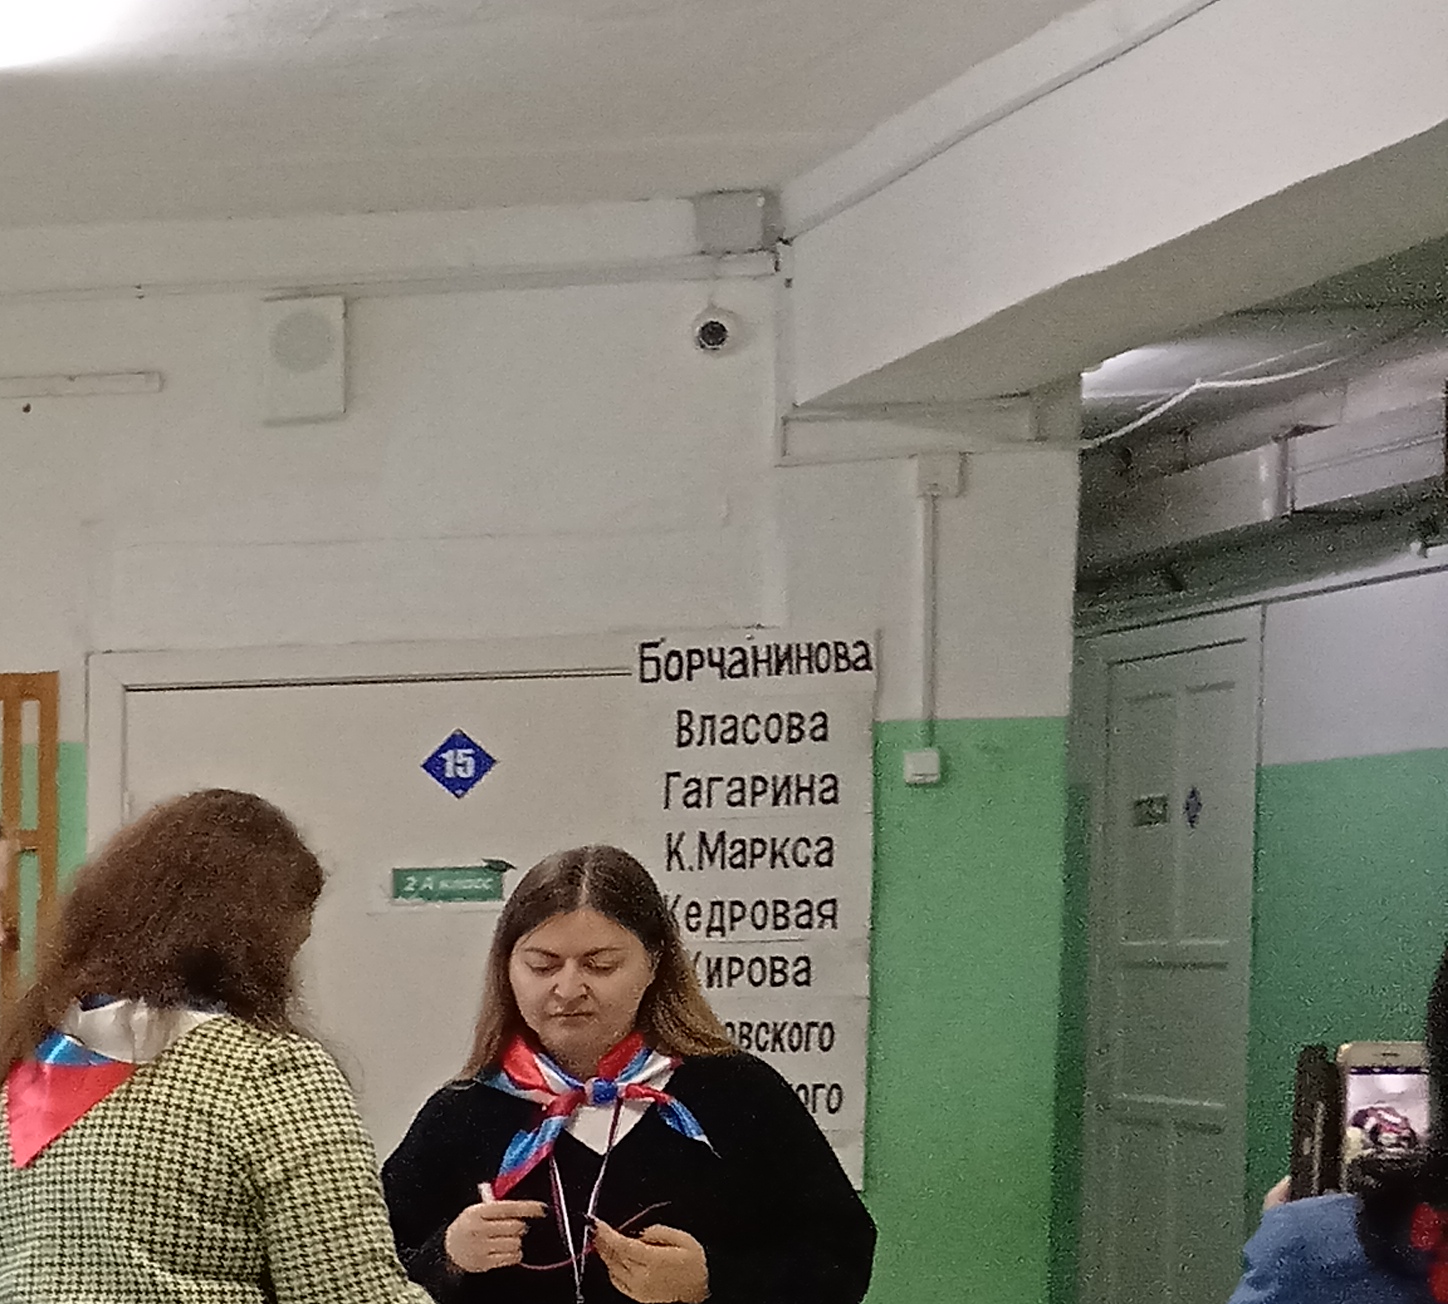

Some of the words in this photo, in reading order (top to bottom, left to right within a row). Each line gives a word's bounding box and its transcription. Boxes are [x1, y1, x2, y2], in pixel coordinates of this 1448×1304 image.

[639, 639, 873, 683] Борчанинова
[676, 709, 829, 748] Власова
[440, 749, 475, 778] 15
[663, 772, 840, 810] Гагарина
[666, 830, 834, 871] К.Маркса
[695, 951, 812, 988] ирова
